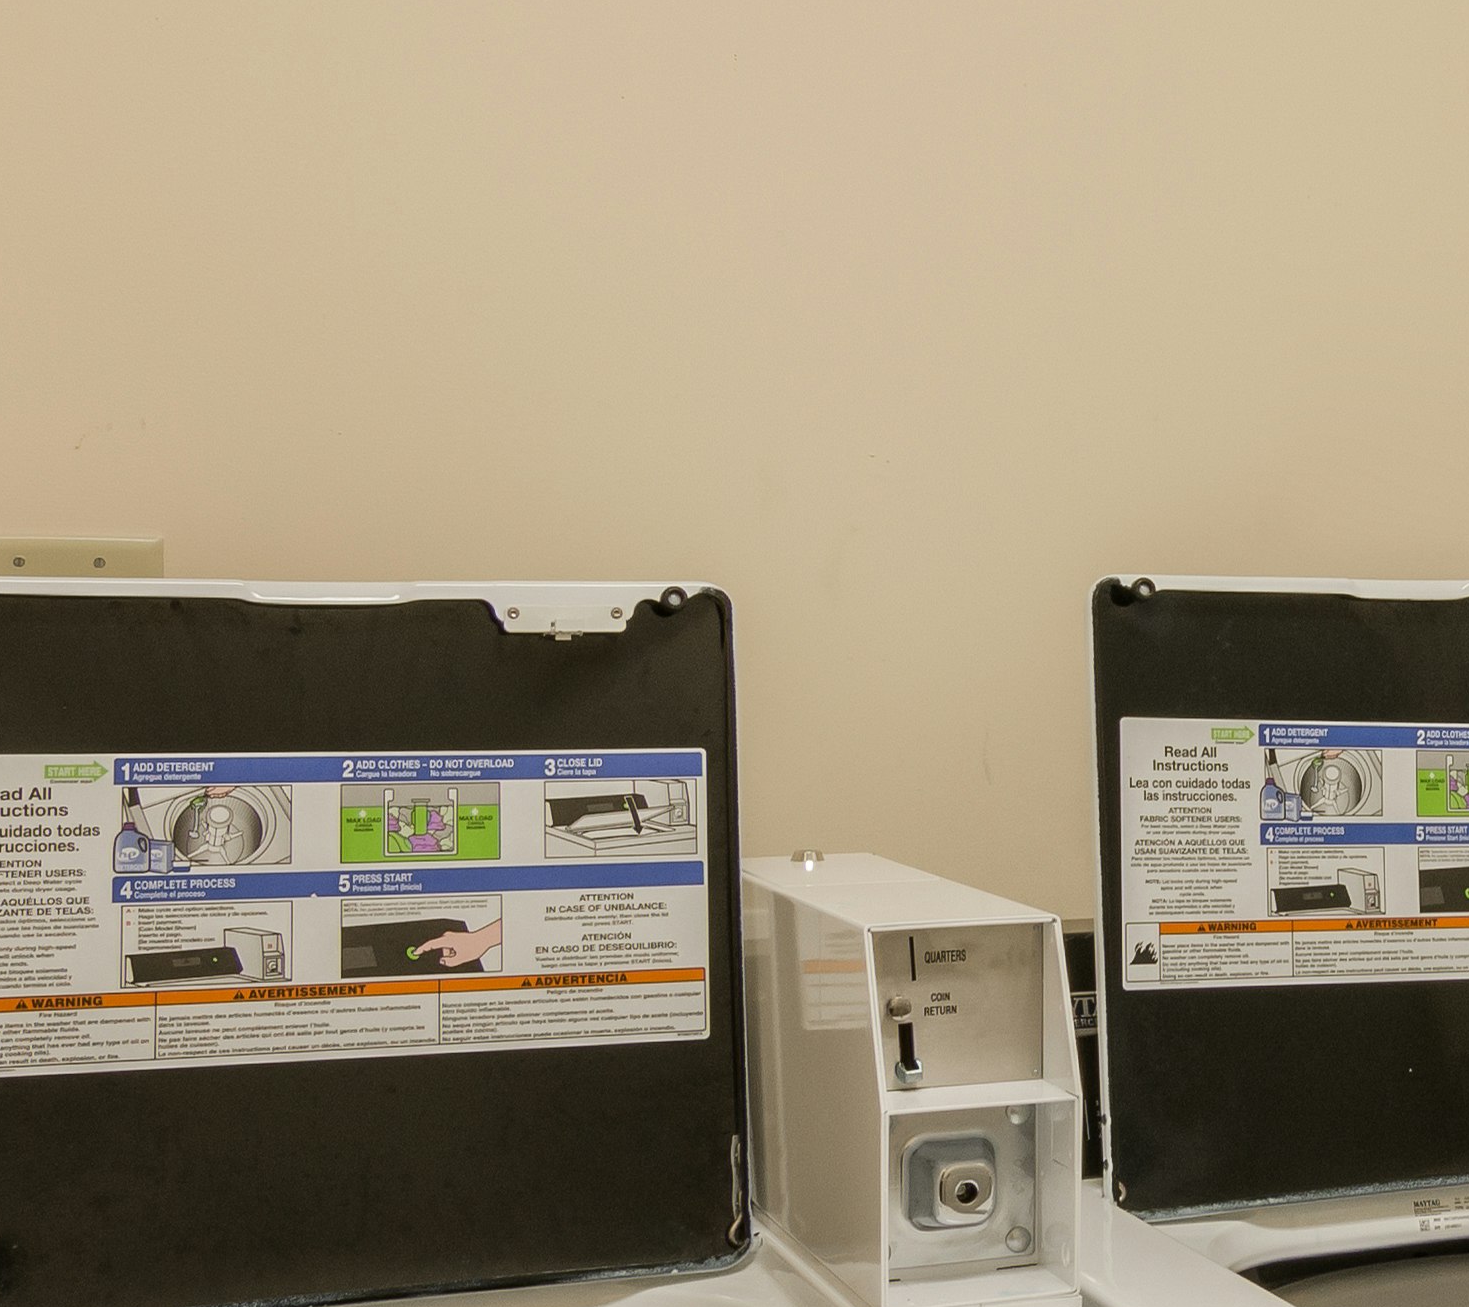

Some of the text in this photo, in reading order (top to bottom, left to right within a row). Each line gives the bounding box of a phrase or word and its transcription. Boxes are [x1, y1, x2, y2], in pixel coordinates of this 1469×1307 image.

[1263, 728, 1270, 743] 1
[1416, 730, 1425, 745] 2
[1164, 746, 1217, 758] Read All
[121, 761, 215, 781] 1 ADD DETERGENT
[342, 758, 515, 778] 2 ADD CLOTHES DO NOT OVERLOAD
[544, 758, 603, 776] 3 CLOSE LID
[1153, 760, 1229, 772] Instructions
[1129, 777, 1251, 789] Lea con cuidado todas
[29, 787, 52, 800] All
[1144, 790, 1237, 801] las instrucciones.
[57, 824, 100, 837] todas
[1265, 827, 1275, 842] 4
[1416, 826, 1425, 841] 5
[45, 868, 87, 878] USERS:
[120, 878, 236, 899] 4 COMPLETE PROCESS
[338, 873, 413, 892] 5 PRESS START
[0, 896, 63, 907] AQUÉLLOS
[65, 896, 90, 906] QUE
[579, 893, 634, 902] ATTENTION
[37, 907, 53, 916] DE
[55, 906, 94, 916] TELAS:
[545, 902, 667, 914] IN CASE OF UNBALANCE:
[1208, 922, 1257, 931] WARNING
[1356, 919, 1438, 929] AVERTISSEMENT
[581, 931, 632, 941] ATENCIÓN
[535, 941, 677, 955] EN CASO DE DESEQUILIBRIO:
[924, 948, 967, 964] QUARTERS
[535, 973, 628, 986] ADVERTENCIA
[248, 984, 366, 999] AVERTISSEMENT
[930, 992, 951, 1002] COIN
[31, 996, 103, 1008] WARNING
[924, 1004, 958, 1016] RETURN
